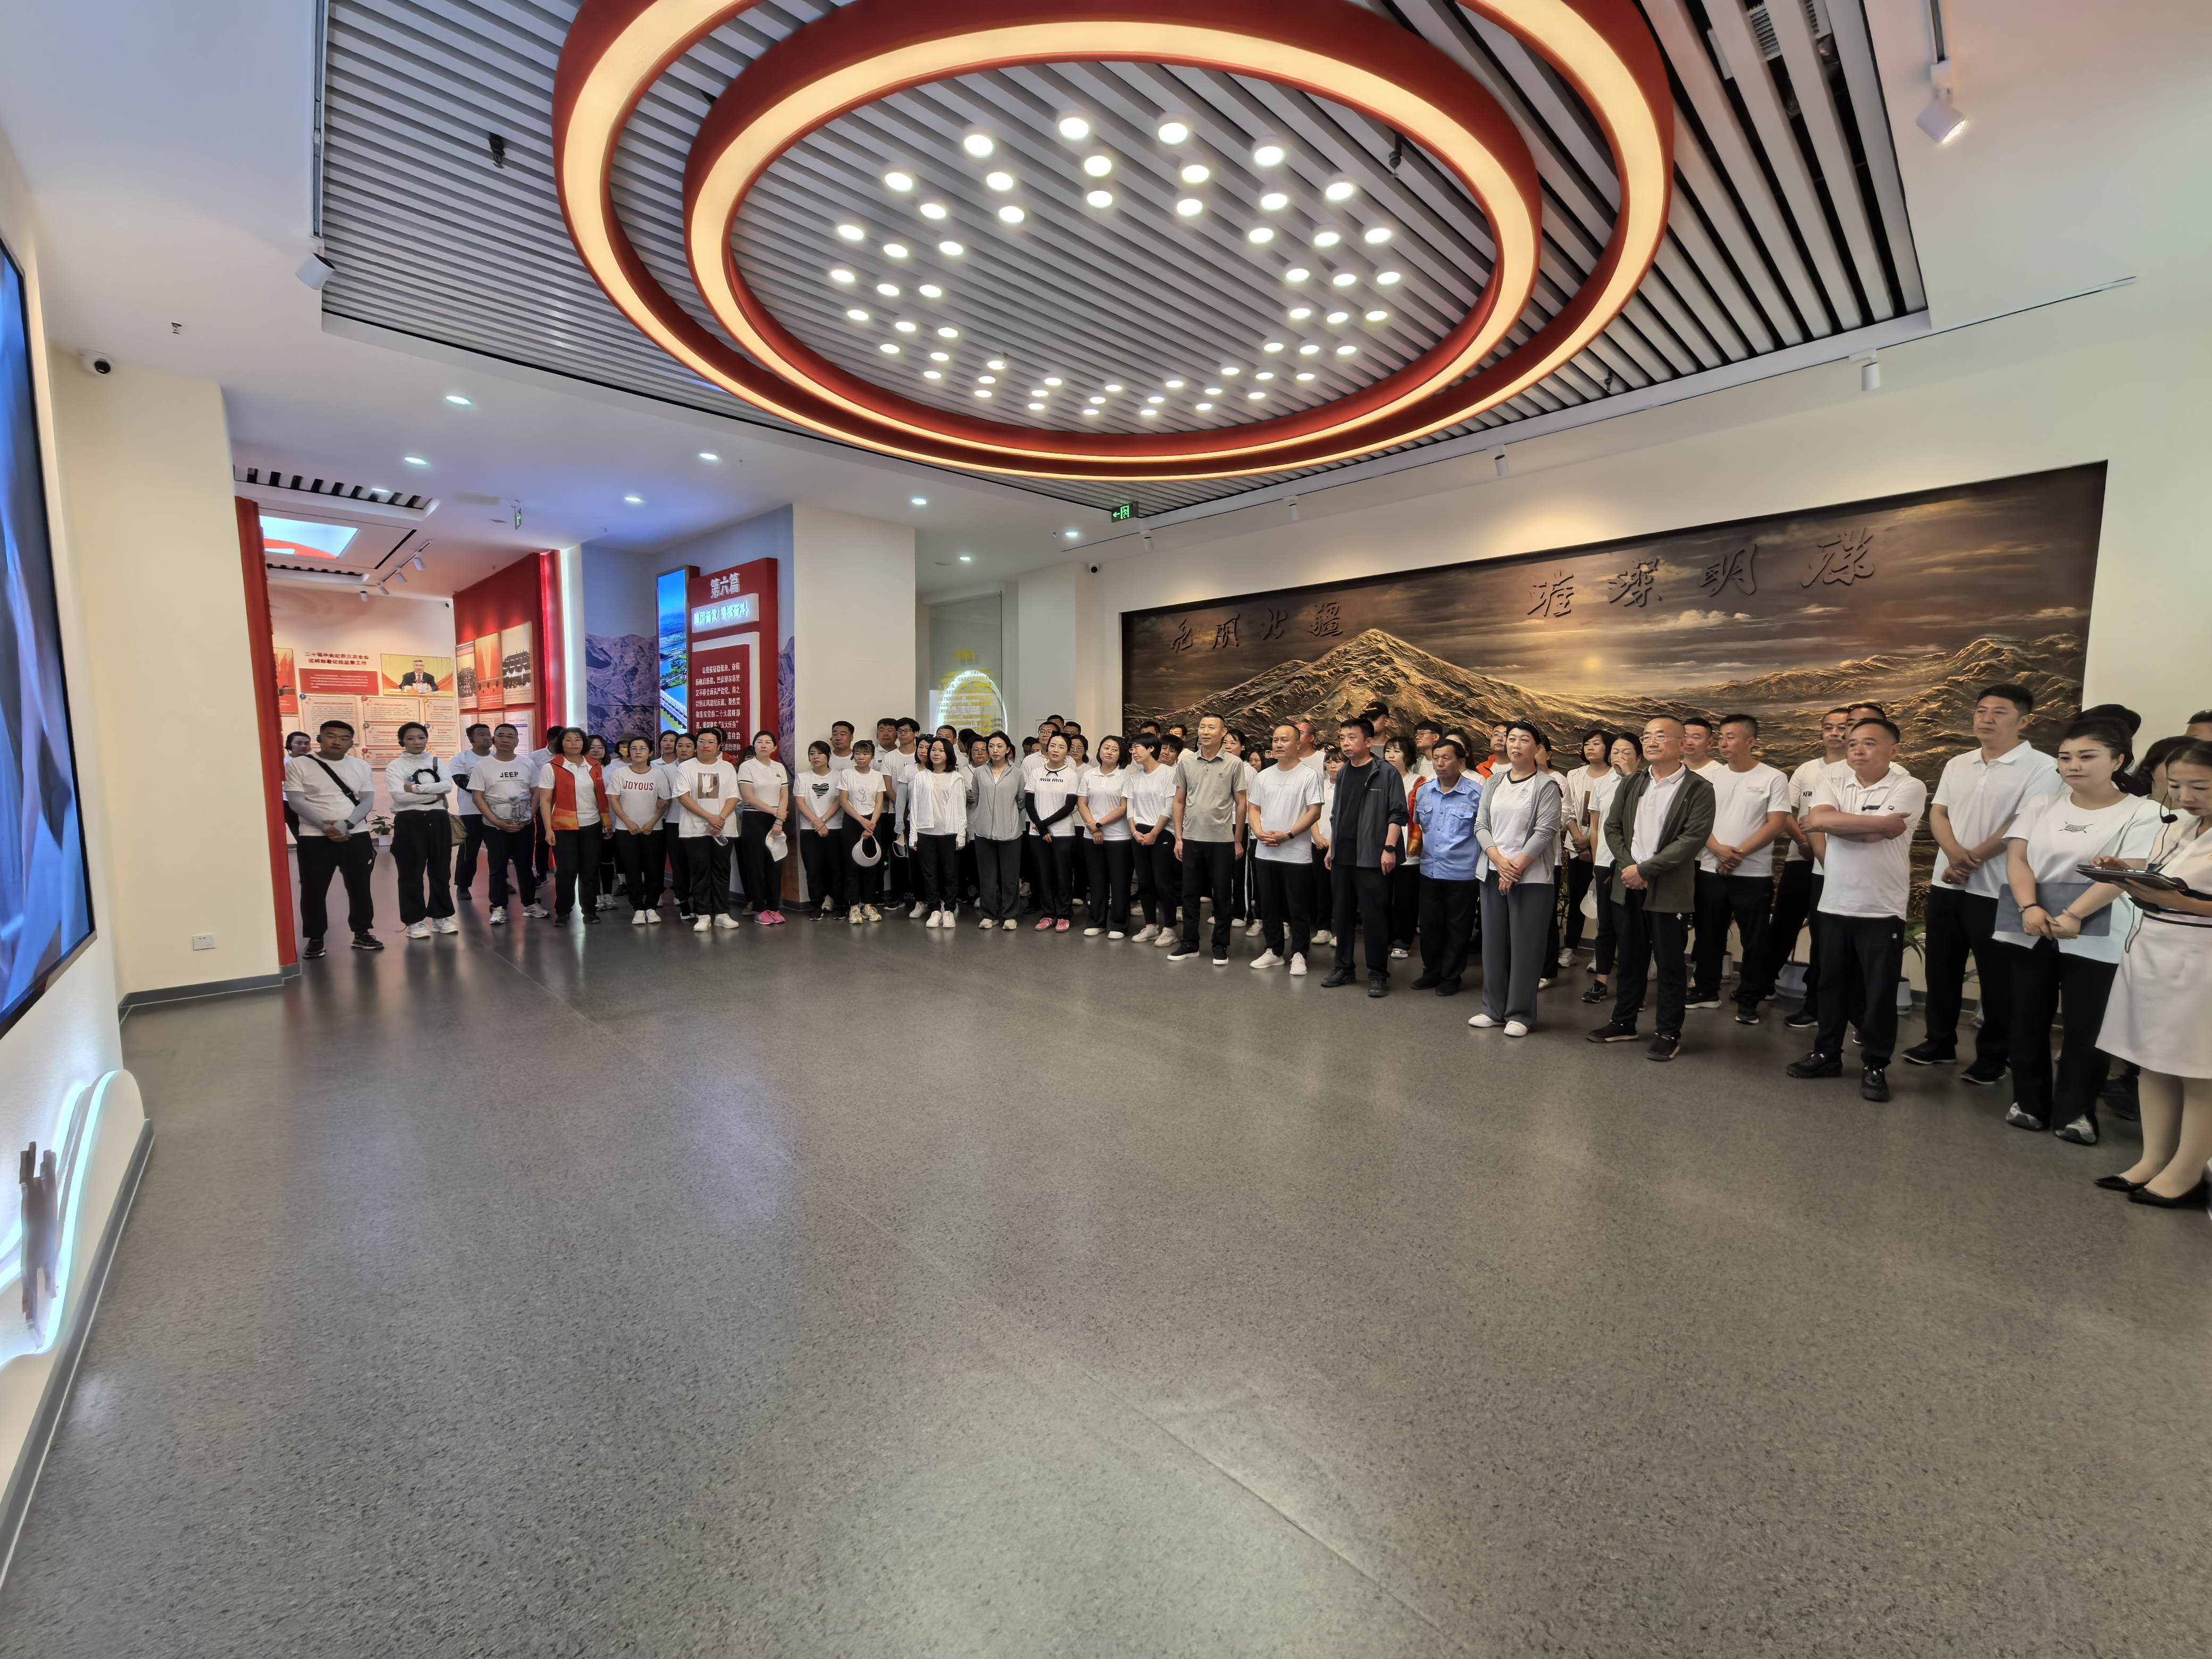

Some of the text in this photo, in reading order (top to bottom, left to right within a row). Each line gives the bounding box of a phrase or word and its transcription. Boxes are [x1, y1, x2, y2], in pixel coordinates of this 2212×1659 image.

[710, 572, 740, 599] 第六篇
[623, 781, 654, 791] JOYOUS
